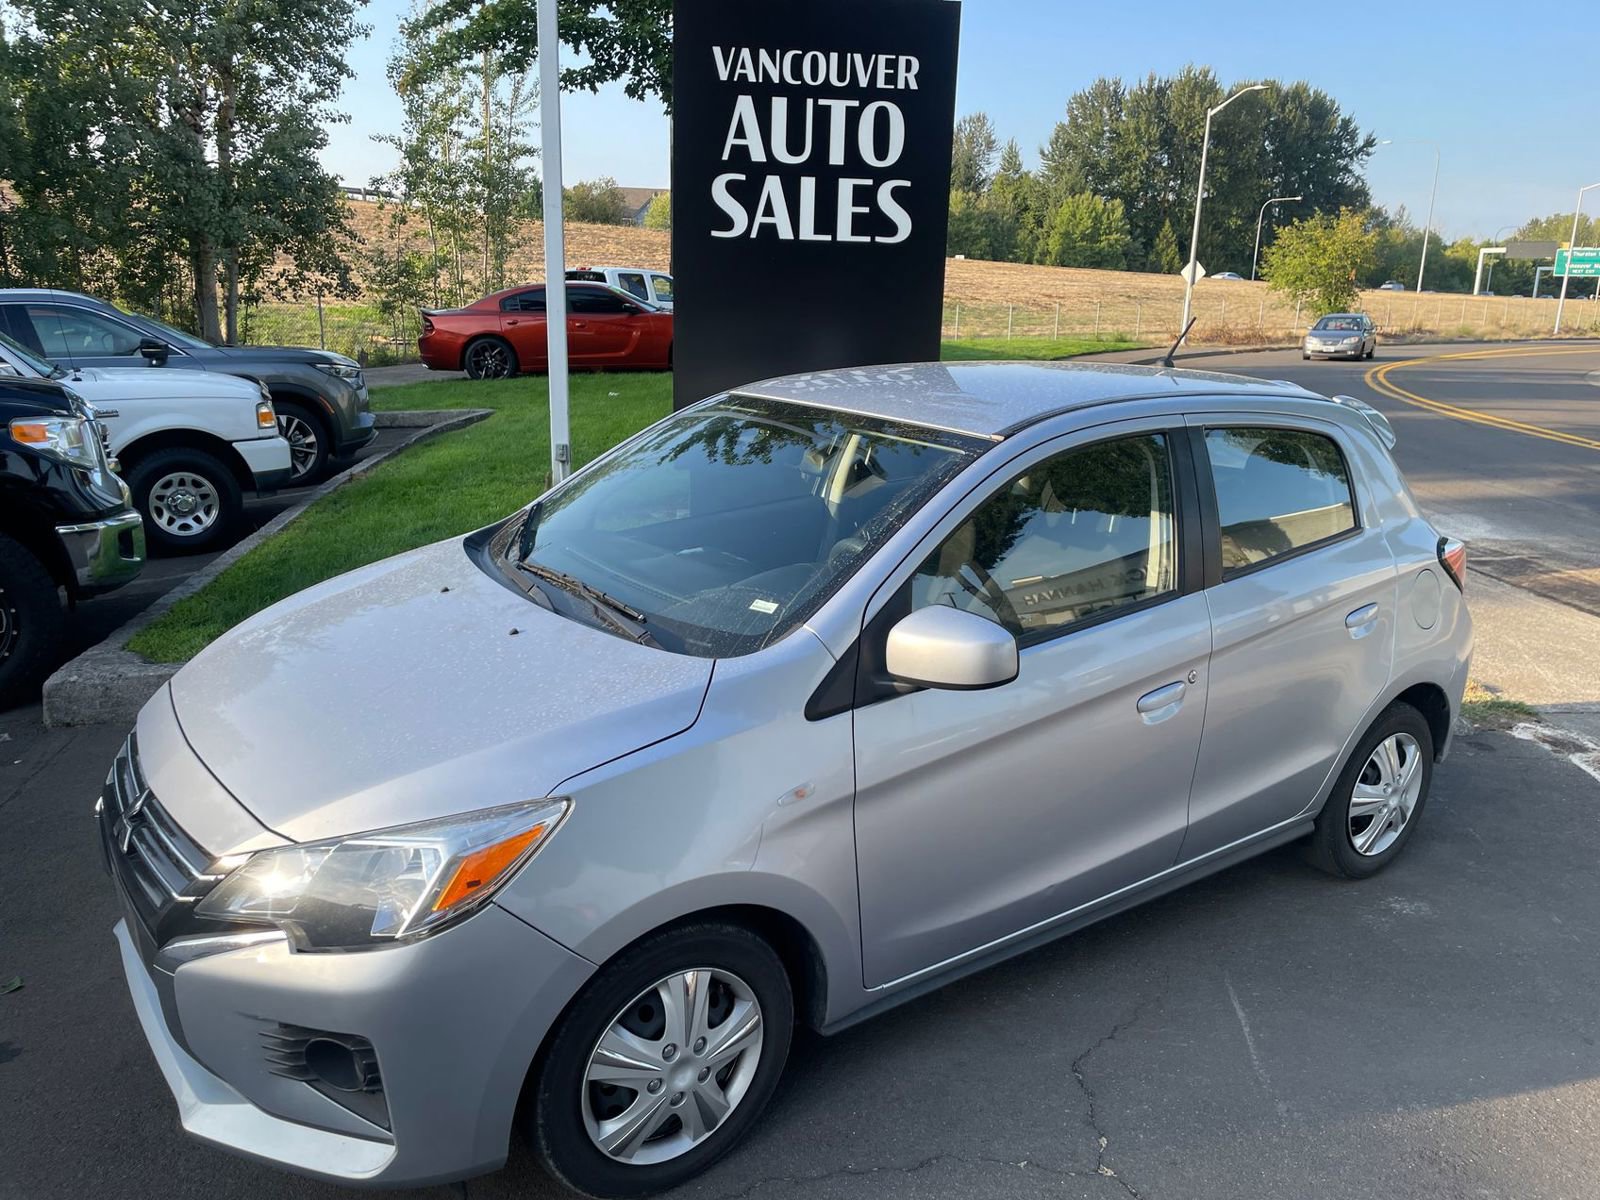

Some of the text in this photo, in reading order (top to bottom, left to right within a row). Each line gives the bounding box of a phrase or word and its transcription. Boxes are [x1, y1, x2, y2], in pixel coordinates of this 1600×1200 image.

[712, 45, 920, 90] VANCOUVER
[721, 94, 906, 168] AUTO
[710, 172, 913, 244] SALES
